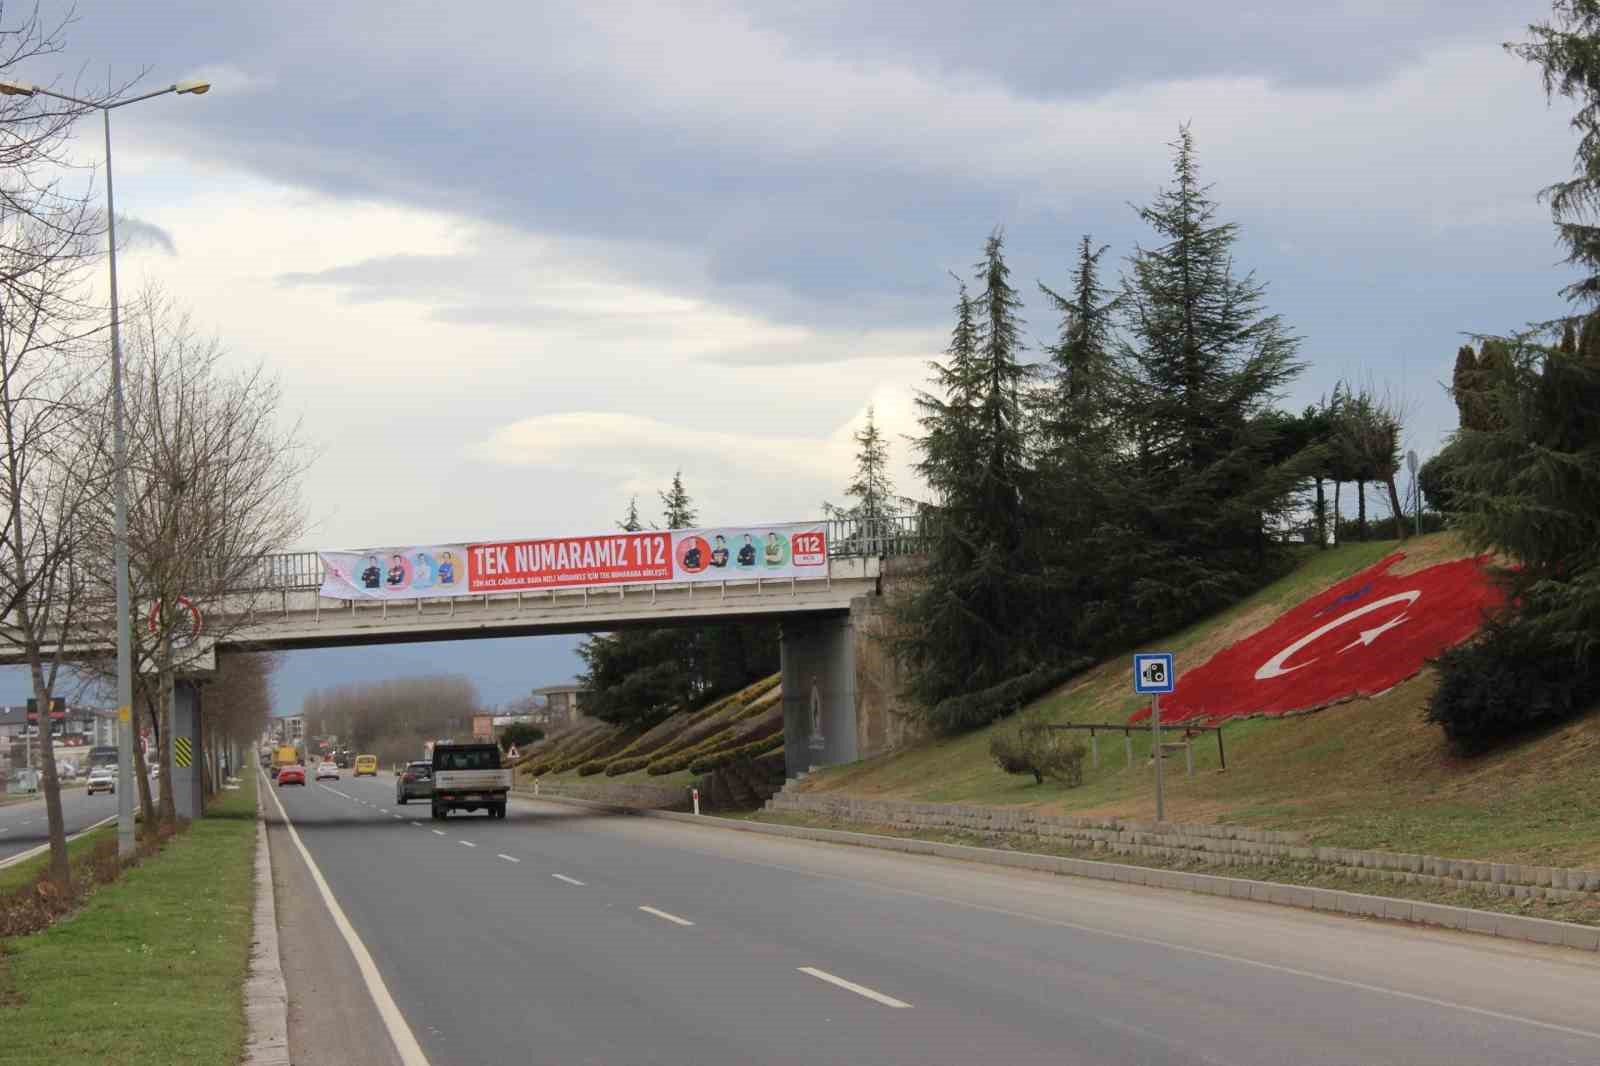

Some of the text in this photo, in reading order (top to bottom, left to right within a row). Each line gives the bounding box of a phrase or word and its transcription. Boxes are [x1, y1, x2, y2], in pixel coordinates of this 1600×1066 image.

[474, 536, 665, 575] TEK NUMARAMIZ 112
[796, 536, 820, 553] 112
